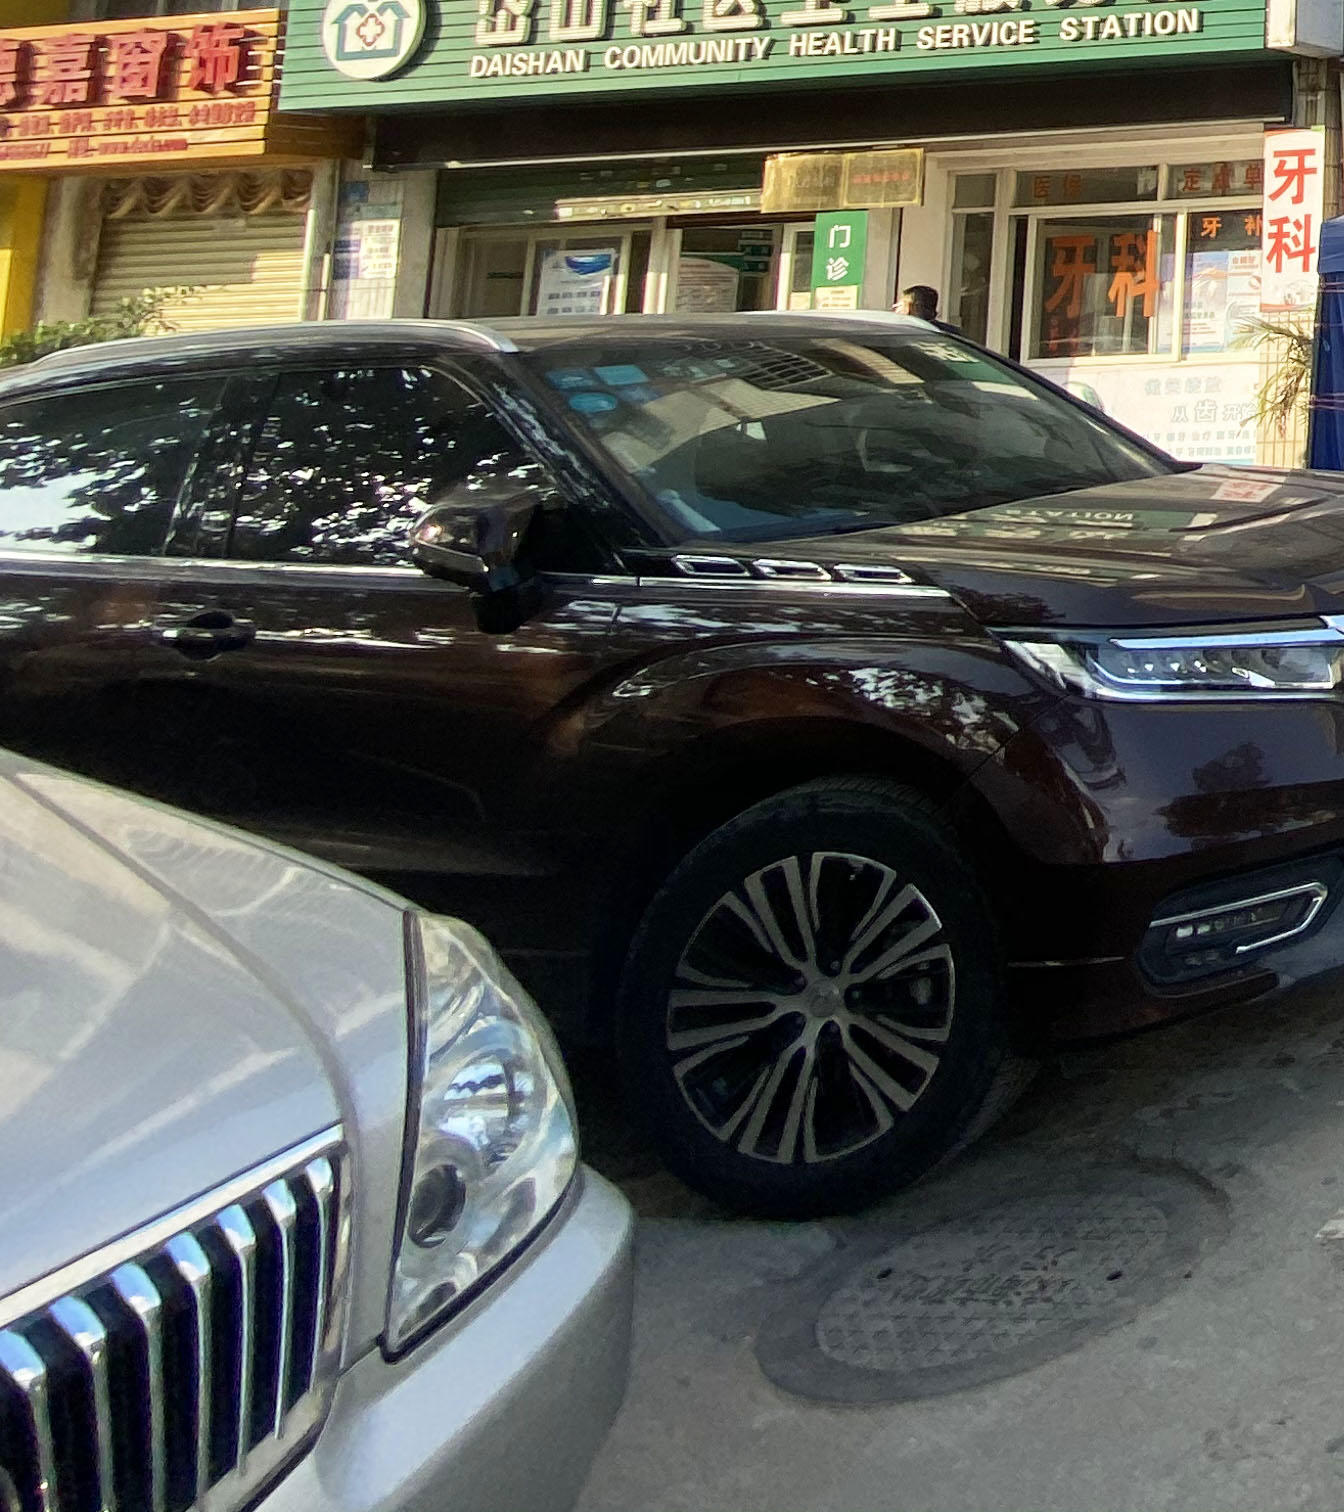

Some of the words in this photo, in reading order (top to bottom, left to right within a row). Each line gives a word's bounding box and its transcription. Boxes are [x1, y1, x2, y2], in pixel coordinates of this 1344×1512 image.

[470, 49, 587, 79] DAISHAN
[603, 35, 770, 71] COMMUNITY
[788, 27, 897, 58] HEALTH
[915, 19, 1035, 51] SERVICE
[1058, 8, 1200, 42] STATION
[1266, 148, 1318, 273] 牙科
[825, 224, 851, 281] 门诊
[1044, 229, 1159, 319] 牙科
